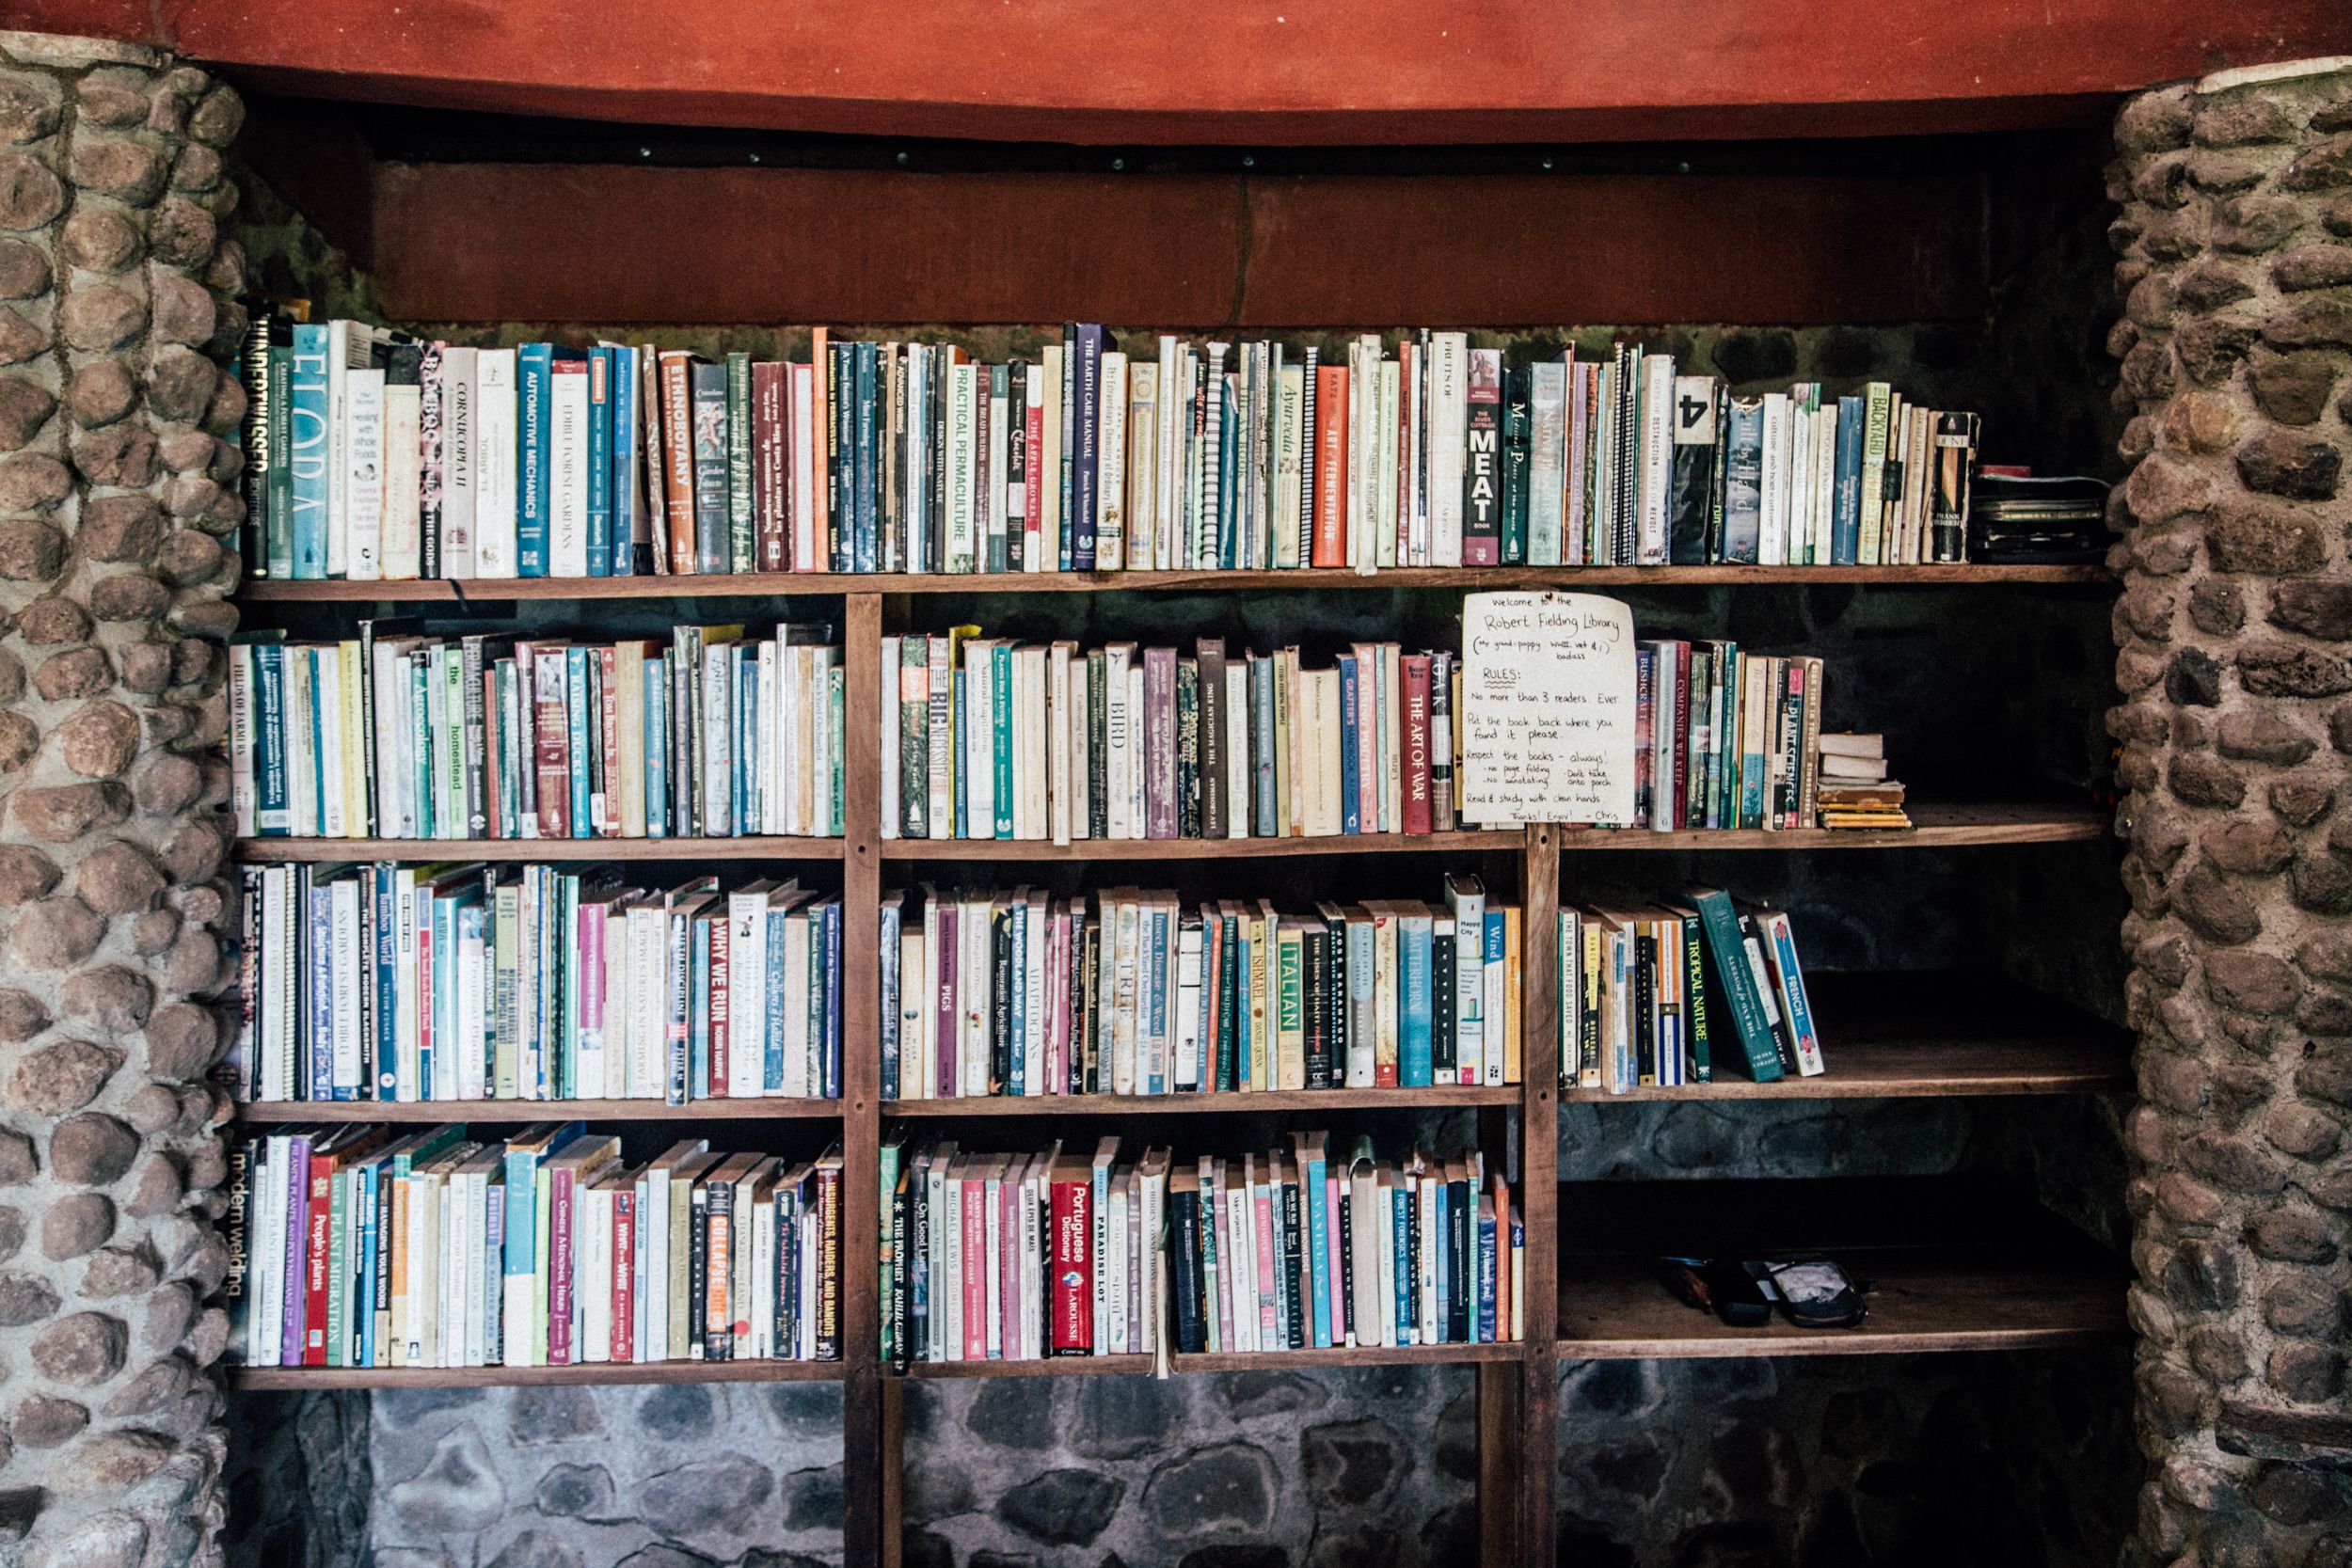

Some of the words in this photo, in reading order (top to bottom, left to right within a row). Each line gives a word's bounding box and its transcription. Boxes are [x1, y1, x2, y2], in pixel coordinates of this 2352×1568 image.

[1085, 339, 1094, 357] THE
[896, 366, 905, 405] ADVANCED
[1085, 359, 1093, 390] EARTH
[246, 320, 268, 472] HUNDERTWASSER
[526, 372, 537, 447] AUTOMOTIVE
[955, 368, 968, 436] PRACTICAL
[1084, 392, 1093, 417] CARE
[1679, 394, 1708, 429] 4
[456, 382, 467, 473] CORNUCOPIA
[670, 365, 689, 486] ETHNOBOTANY
[896, 406, 905, 434] WIRING
[937, 420, 946, 449] DESIGN
[1029, 420, 1039, 438] THE
[1282, 385, 1297, 453] Ayurveda
[1869, 397, 1886, 455] BACKYARD
[1083, 419, 1092, 459] MANUAL
[1326, 430, 1338, 449] ART
[525, 449, 537, 518] MECHANICS
[936, 473, 945, 504] NATURE
[954, 439, 967, 541] PERMACULTURE
[1470, 430, 1497, 521] MEAT
[1324, 460, 1338, 540] FERMENTATION
[1493, 598, 1532, 607] Welcome
[1557, 596, 1571, 606] the
[1485, 614, 1531, 631] Robert
[1538, 613, 1578, 639] Fielding
[1584, 614, 1619, 642] Library
[234, 664, 246, 697] FIELDS
[450, 666, 459, 685] the
[1432, 663, 1447, 707] OAK
[1484, 667, 1521, 680] RULES:
[235, 698, 246, 709] OF
[572, 673, 582, 727] RAISING
[930, 692, 947, 723] BIG
[1410, 694, 1423, 722] THE
[1518, 692, 1538, 702] than
[1543, 693, 1549, 703] 3
[1676, 679, 1684, 739] COMPANIES
[235, 712, 246, 755] FARMERS
[412, 685, 427, 765] Agroecology
[1111, 703, 1125, 749] BIRD
[1410, 723, 1423, 749] ART
[1468, 713, 1480, 723] Put
[1487, 716, 1501, 725] the
[1508, 716, 1530, 726] book
[1538, 716, 1562, 726] back
[1565, 719, 1590, 727] where
[1597, 720, 1613, 731] you
[1475, 728, 1498, 742] found
[1507, 730, 1517, 739] it
[452, 725, 461, 789] homestead
[573, 731, 583, 776] DUCKS
[930, 726, 948, 777] NECESSITY
[1411, 750, 1423, 768] OF
[1467, 751, 1494, 764] Respect
[1504, 751, 1518, 760] the
[1528, 752, 1554, 761] books
[1675, 743, 1683, 757] WE
[1412, 772, 1424, 800] WAR
[1504, 766, 1519, 778] page
[1526, 764, 1550, 779] folding
[1589, 768, 1606, 778] take
[1467, 794, 1486, 803] Read
[1489, 793, 1494, 803] &
[1500, 794, 1523, 811] study
[1529, 793, 1547, 803] with
[1547, 810, 1572, 823] Enjoy!
[1595, 810, 1618, 821] Chris
[379, 894, 390, 932] Bamboo
[1014, 911, 1024, 930] THE
[379, 936, 392, 965] World
[711, 926, 727, 958] WHY
[1489, 927, 1501, 958] Wind
[711, 962, 726, 986] WE
[998, 959, 1008, 1003] Restoration
[1014, 932, 1023, 992] WOODLAND
[1153, 952, 1164, 990] Disease
[1252, 956, 1263, 1001] ISHMAEL
[1408, 931, 1422, 1010] MATTERHORN
[1689, 940, 1702, 994] TROPICAL
[941, 985, 951, 1011] PIGS
[1281, 946, 1298, 1026] ITALIAN
[1788, 975, 1804, 1017] FRENCH
[712, 990, 727, 1022] RUN
[1013, 994, 1023, 1017] WAY
[1152, 1006, 1163, 1035] Weed
[1694, 996, 1706, 1041] NATURE
[997, 1006, 1007, 1048] Agriculture
[230, 1153, 246, 1224] modern
[824, 1181, 835, 1239] INSURGENTS,
[895, 1216, 904, 1237] THE
[1071, 1186, 1086, 1263] Portuguese
[312, 1214, 326, 1258] People's
[329, 1212, 342, 1257] PLANT
[710, 1217, 727, 1285] COLLAPSE
[1059, 1216, 1072, 1262] Dictionary
[1097, 1216, 1106, 1278] PARADISE
[229, 1227, 246, 1296] welding
[311, 1259, 325, 1291] plants
[824, 1240, 835, 1279] RAIDERS,
[895, 1240, 904, 1282] PROPHET
[328, 1261, 342, 1344] MIGRATION
[824, 1281, 834, 1298] AND
[1098, 1280, 1106, 1304] LOT
[823, 1300, 834, 1337] BANDITS
[1069, 1289, 1077, 1341] LAROUSSE
